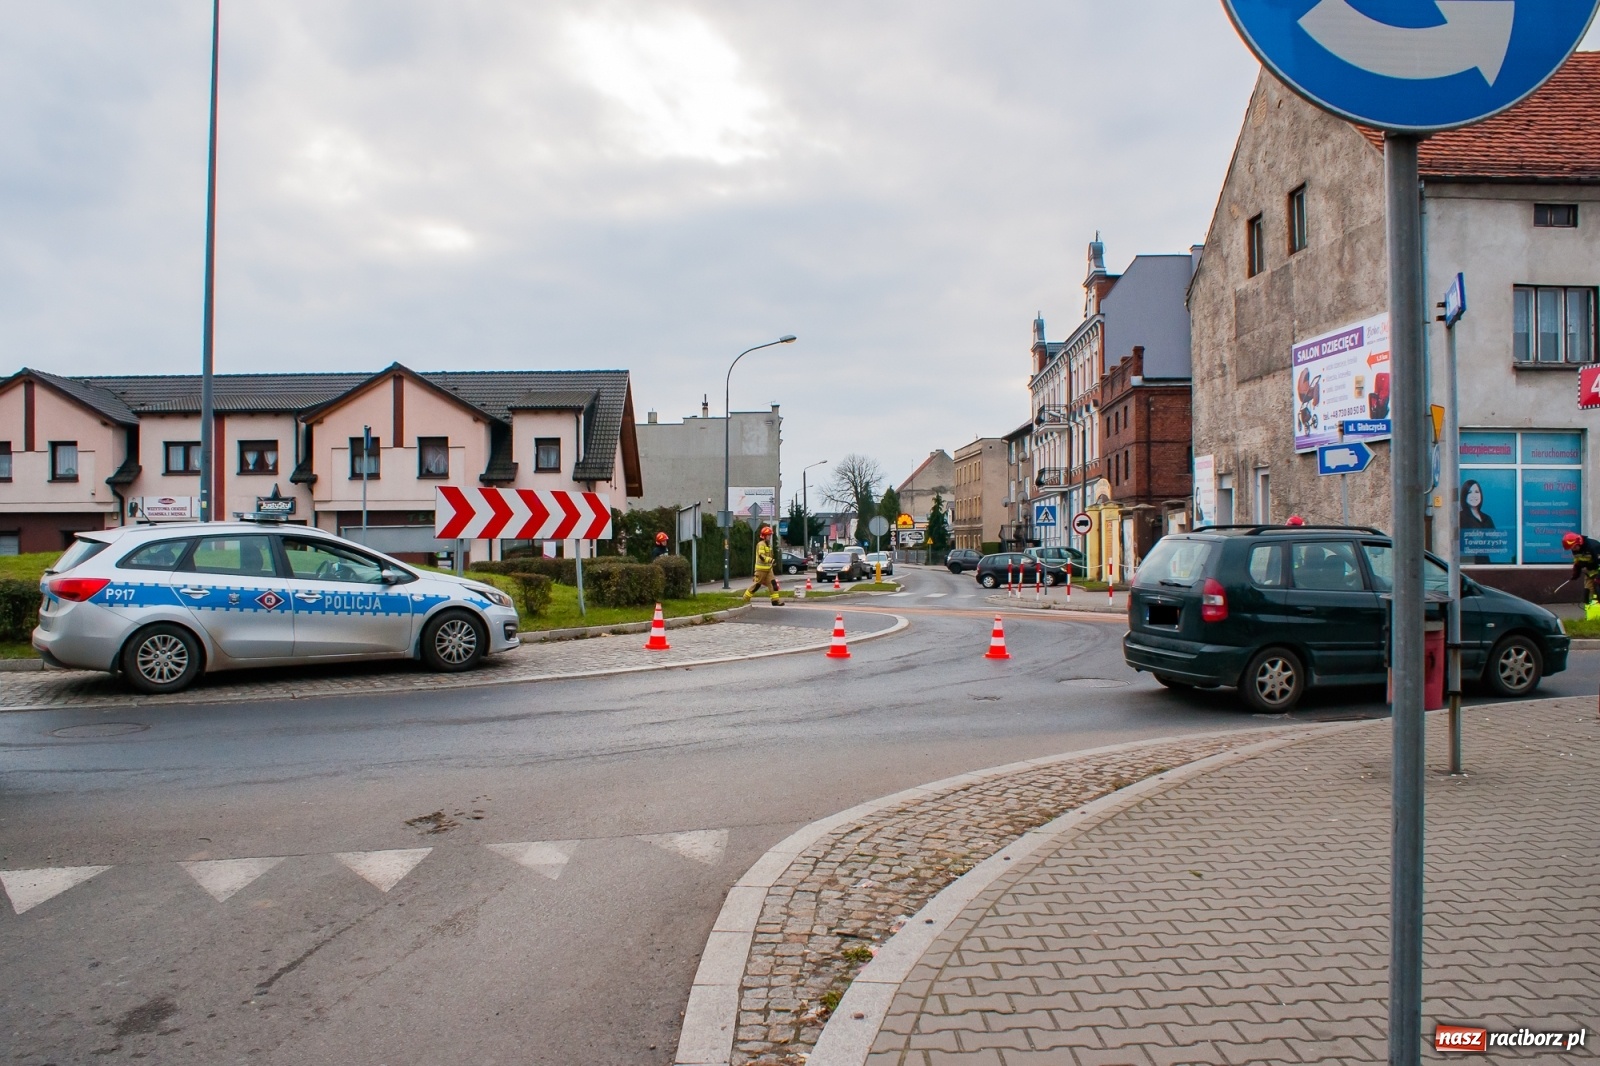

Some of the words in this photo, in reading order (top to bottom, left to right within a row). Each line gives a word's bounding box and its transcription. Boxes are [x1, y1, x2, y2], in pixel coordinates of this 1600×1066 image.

[1297, 345, 1320, 363] SALON
[1321, 332, 1360, 355] DZIECIĘCY
[1348, 423, 1356, 432] ul.
[1460, 443, 1511, 457] ubezpieczenia
[1531, 447, 1579, 458] nieruchomości
[1544, 482, 1554, 491] na
[1557, 481, 1577, 492] życie
[1464, 538, 1508, 546] Towarzystw
[105, 588, 135, 601] P917
[266, 596, 273, 604] R
[325, 595, 382, 610] POLICJA
